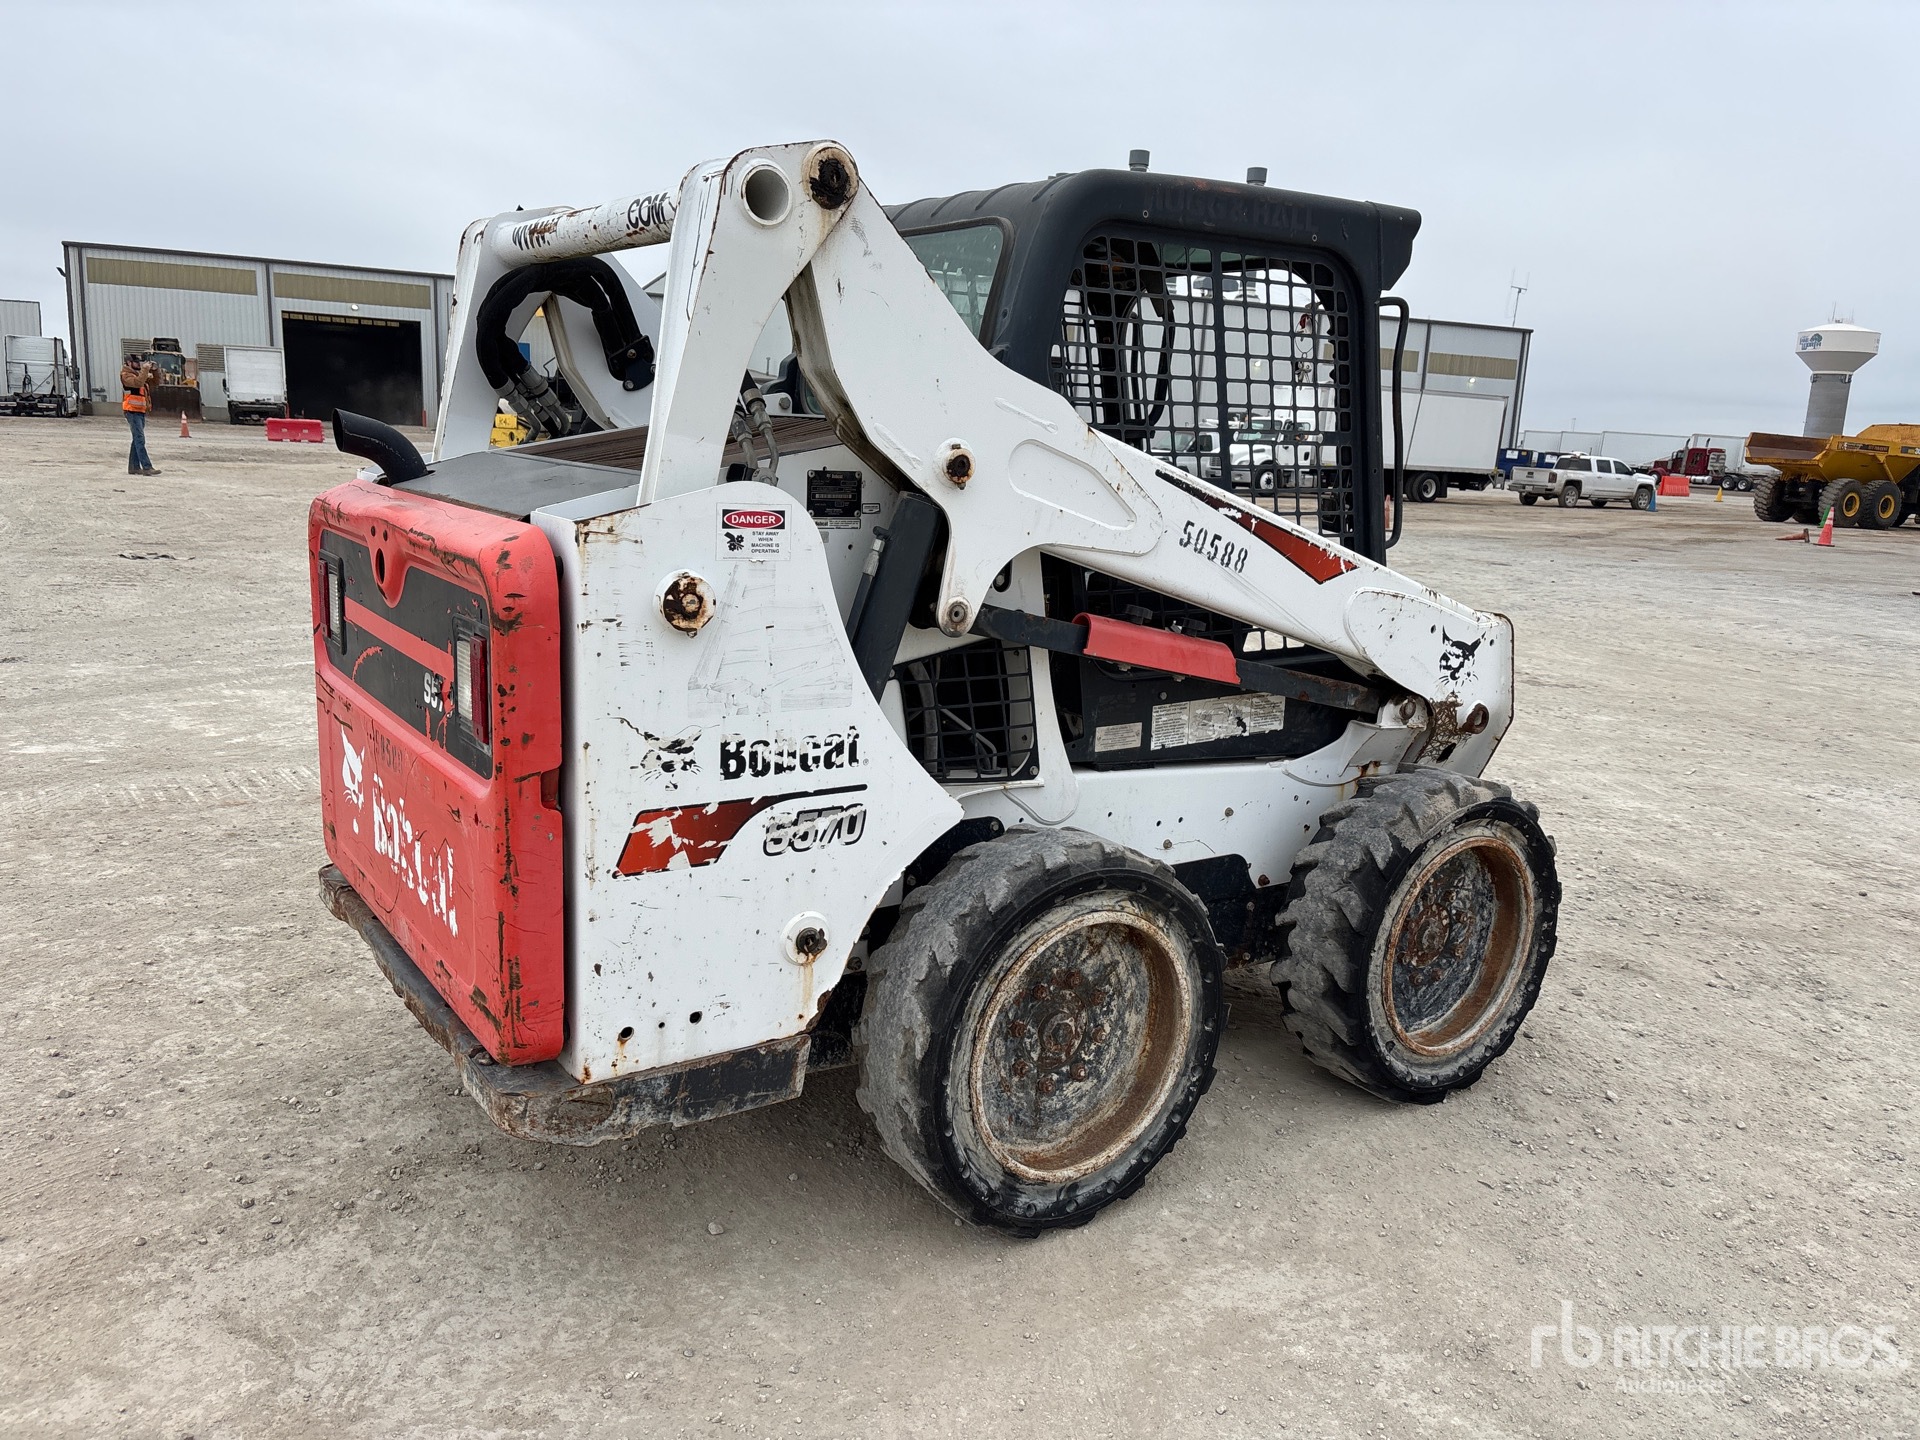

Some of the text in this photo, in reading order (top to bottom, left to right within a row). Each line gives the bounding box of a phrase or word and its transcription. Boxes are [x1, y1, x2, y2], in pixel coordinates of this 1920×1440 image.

[731, 514, 776, 525] DANGER
[1179, 519, 1249, 574] 50588
[720, 725, 860, 781] Bobcat
[763, 802, 867, 857] S570
